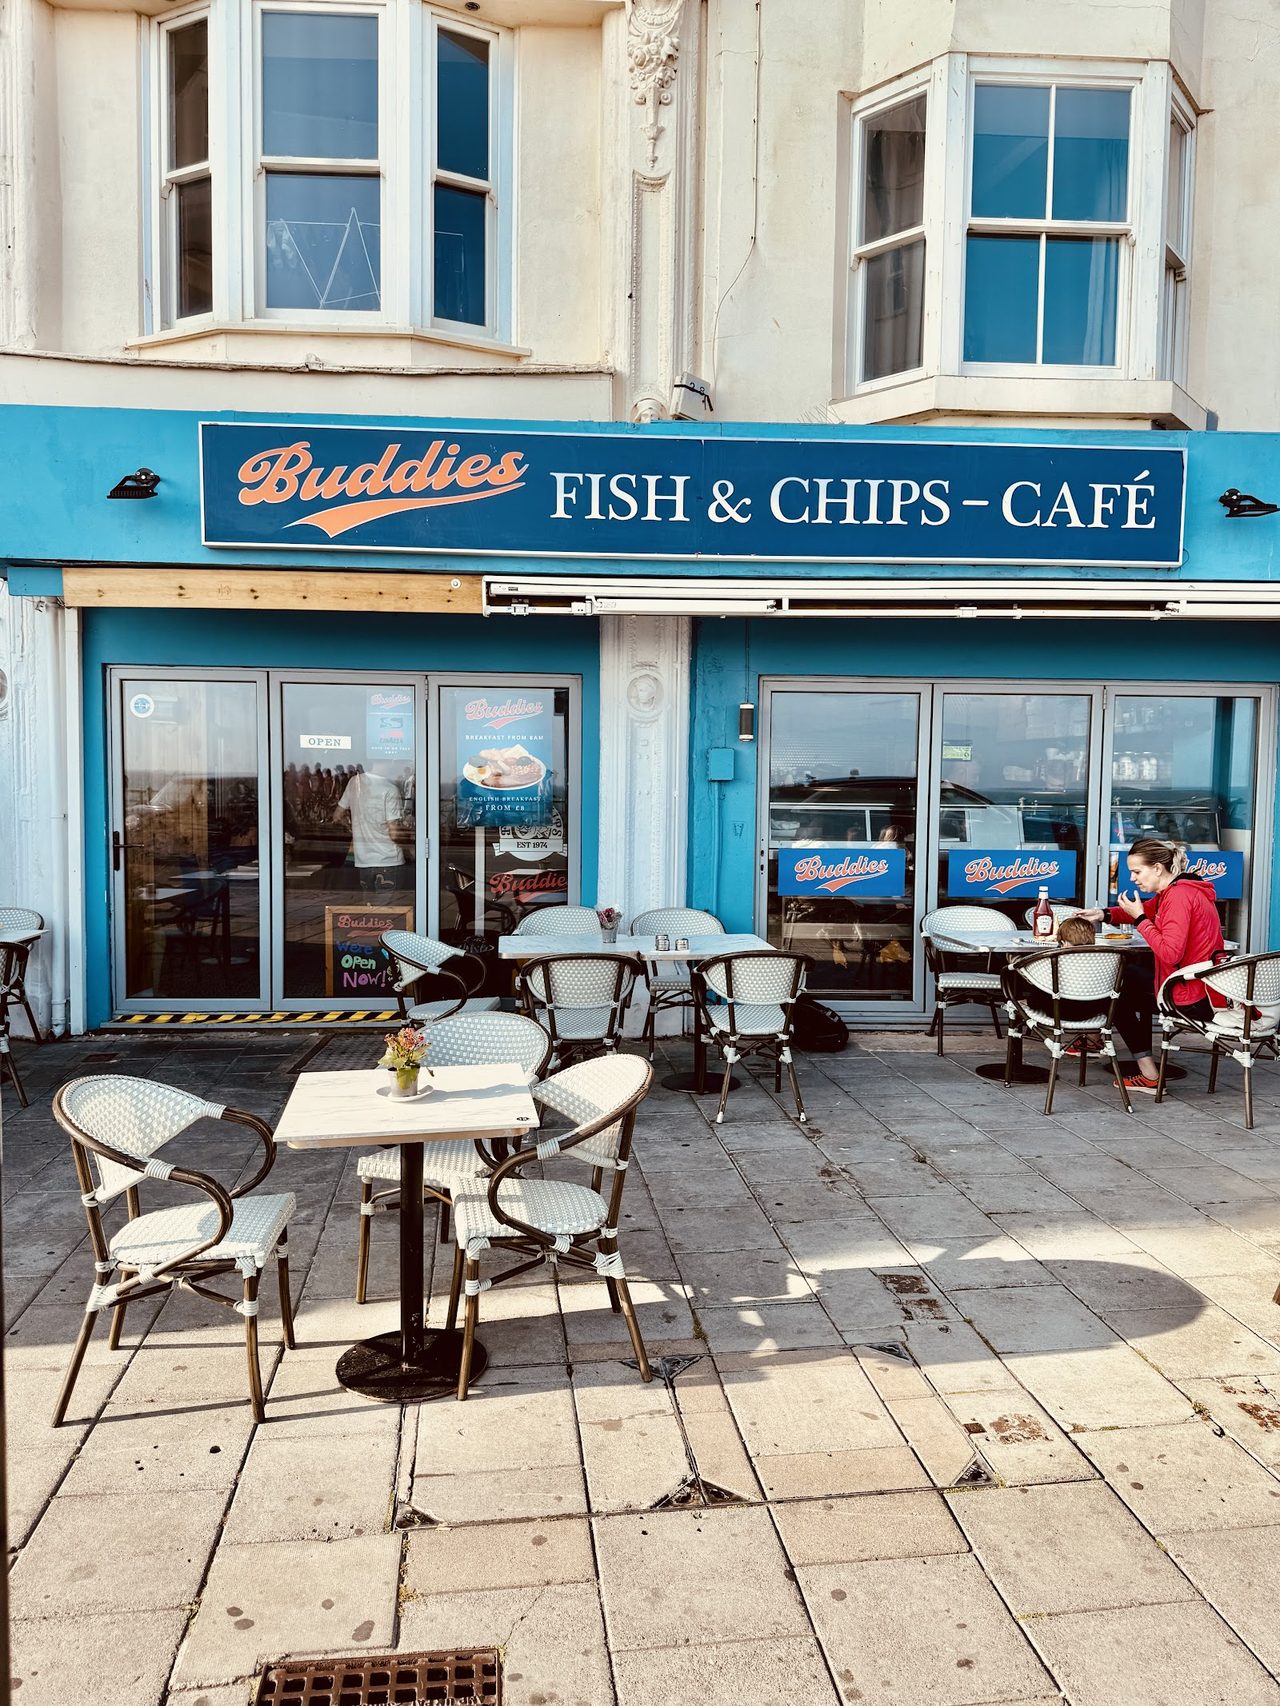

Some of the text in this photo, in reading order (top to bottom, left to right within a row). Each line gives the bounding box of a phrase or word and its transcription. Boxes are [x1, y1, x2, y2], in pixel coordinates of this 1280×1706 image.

[237, 440, 529, 506] Buddies
[549, 472, 691, 522] FISH
[707, 479, 752, 524] &
[770, 476, 951, 527] CHIPS
[1001, 469, 1156, 530] CAFÉ
[464, 697, 544, 721] Buddies
[308, 737, 341, 747] OPEN
[794, 855, 889, 882] Buddies
[964, 856, 1060, 883] Buddies
